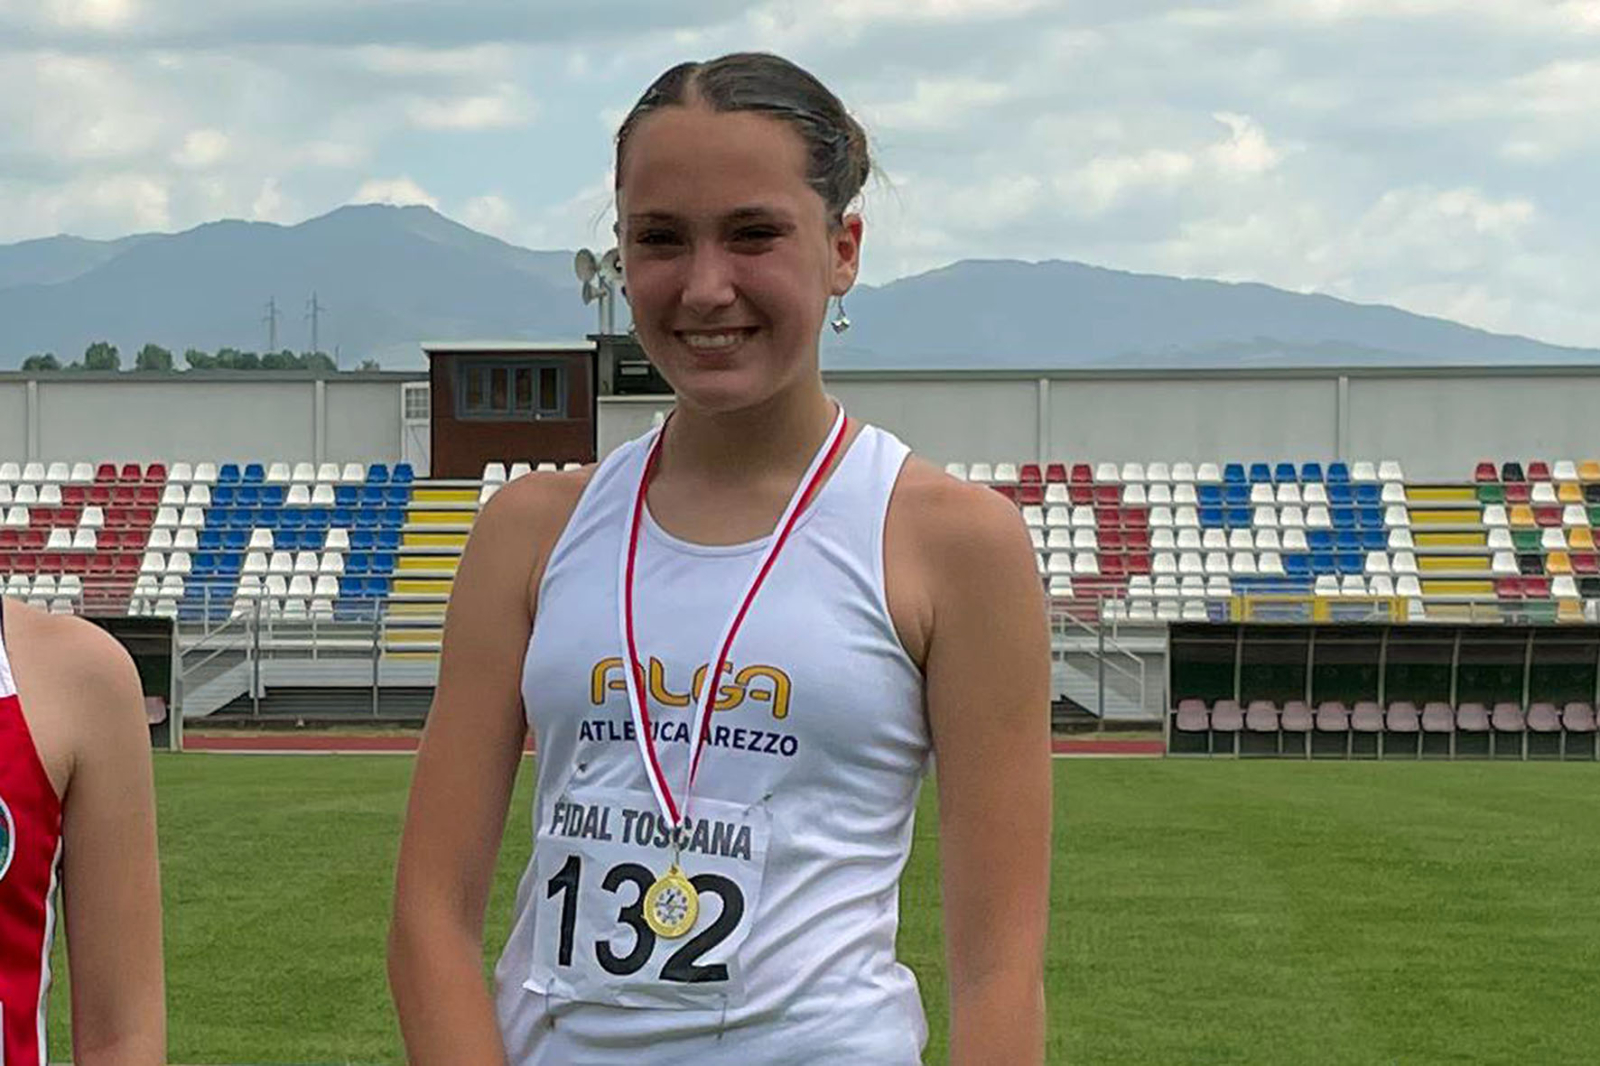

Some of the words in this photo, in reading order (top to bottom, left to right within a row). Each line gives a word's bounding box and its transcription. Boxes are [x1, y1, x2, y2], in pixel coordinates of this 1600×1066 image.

[591, 657, 791, 719] ALGA
[579, 720, 690, 744] ATLEICA
[550, 802, 612, 841] FIDAL
[622, 809, 751, 861] TOSCANA
[547, 855, 745, 983] 132
